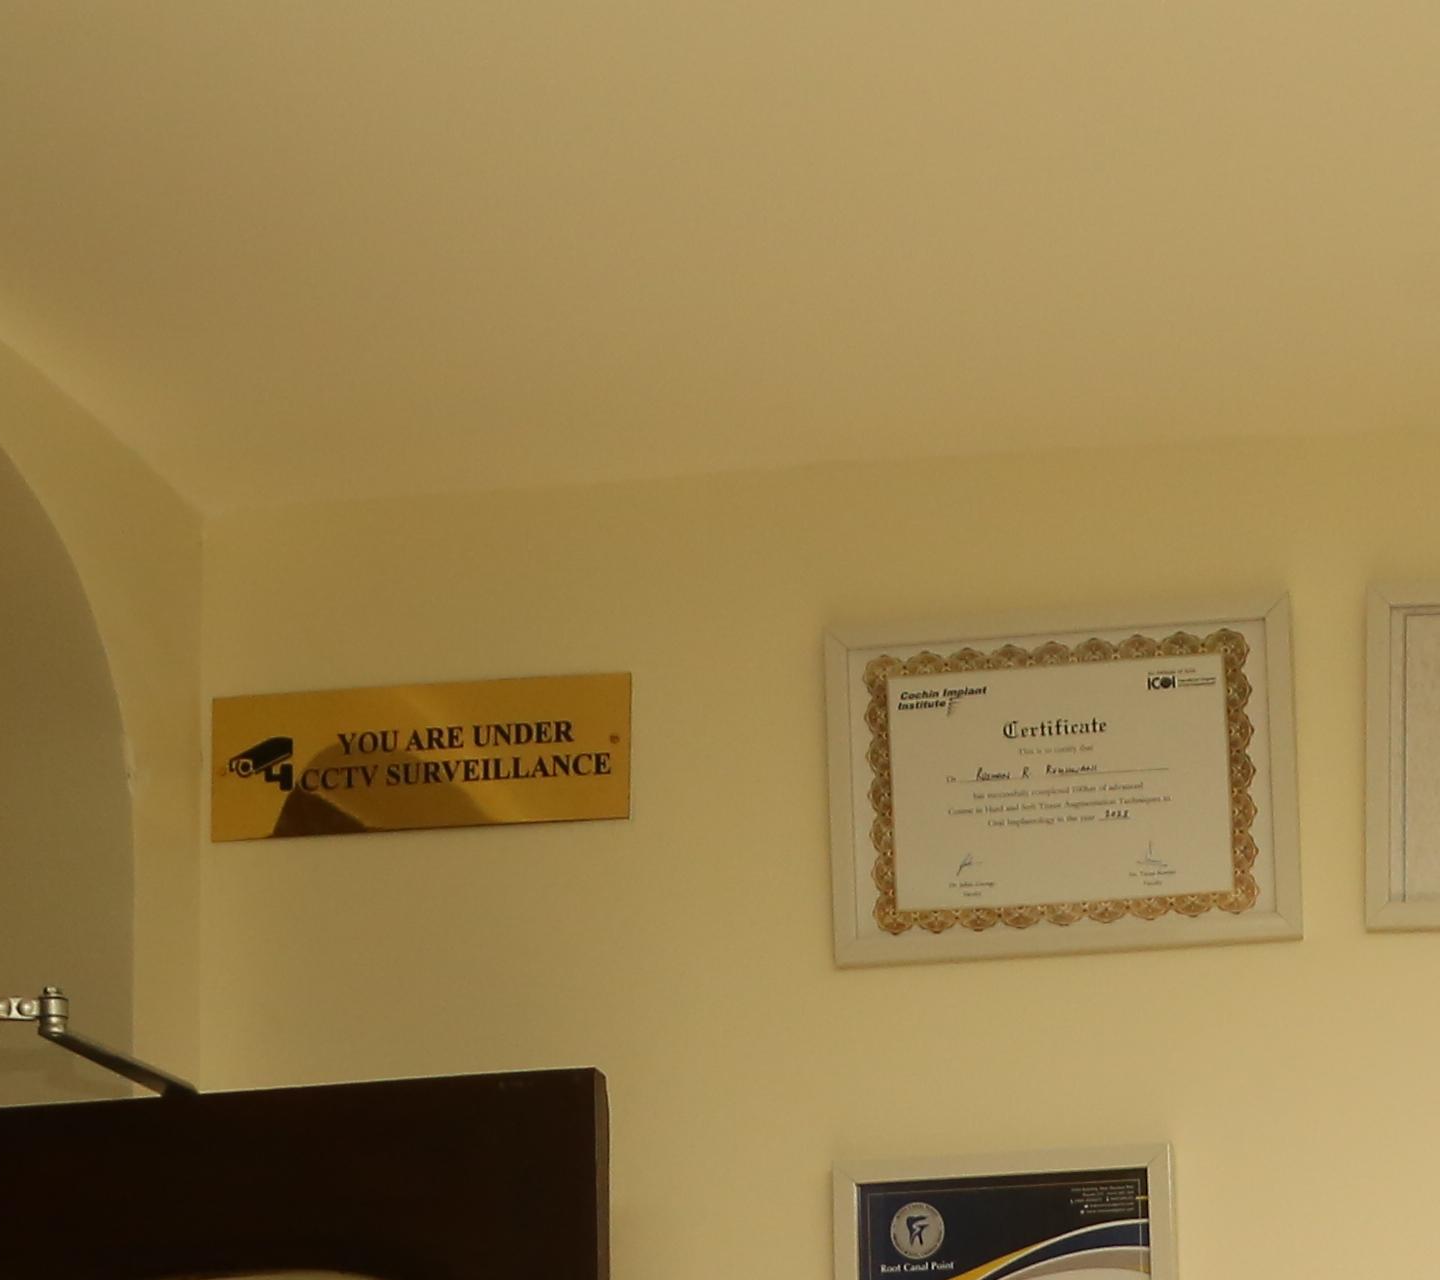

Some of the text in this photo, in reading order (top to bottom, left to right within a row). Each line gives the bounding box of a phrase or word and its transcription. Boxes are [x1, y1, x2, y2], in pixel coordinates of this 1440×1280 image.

[900, 685, 987, 700] Cochin Implant
[897, 699, 946, 710] Institute
[1003, 717, 1107, 739] Certificate
[338, 721, 575, 755] YOU ARE UNDER
[300, 752, 611, 791] CCTV SURVEILLANCE
[881, 1261, 954, 1273] Root Canal Point
